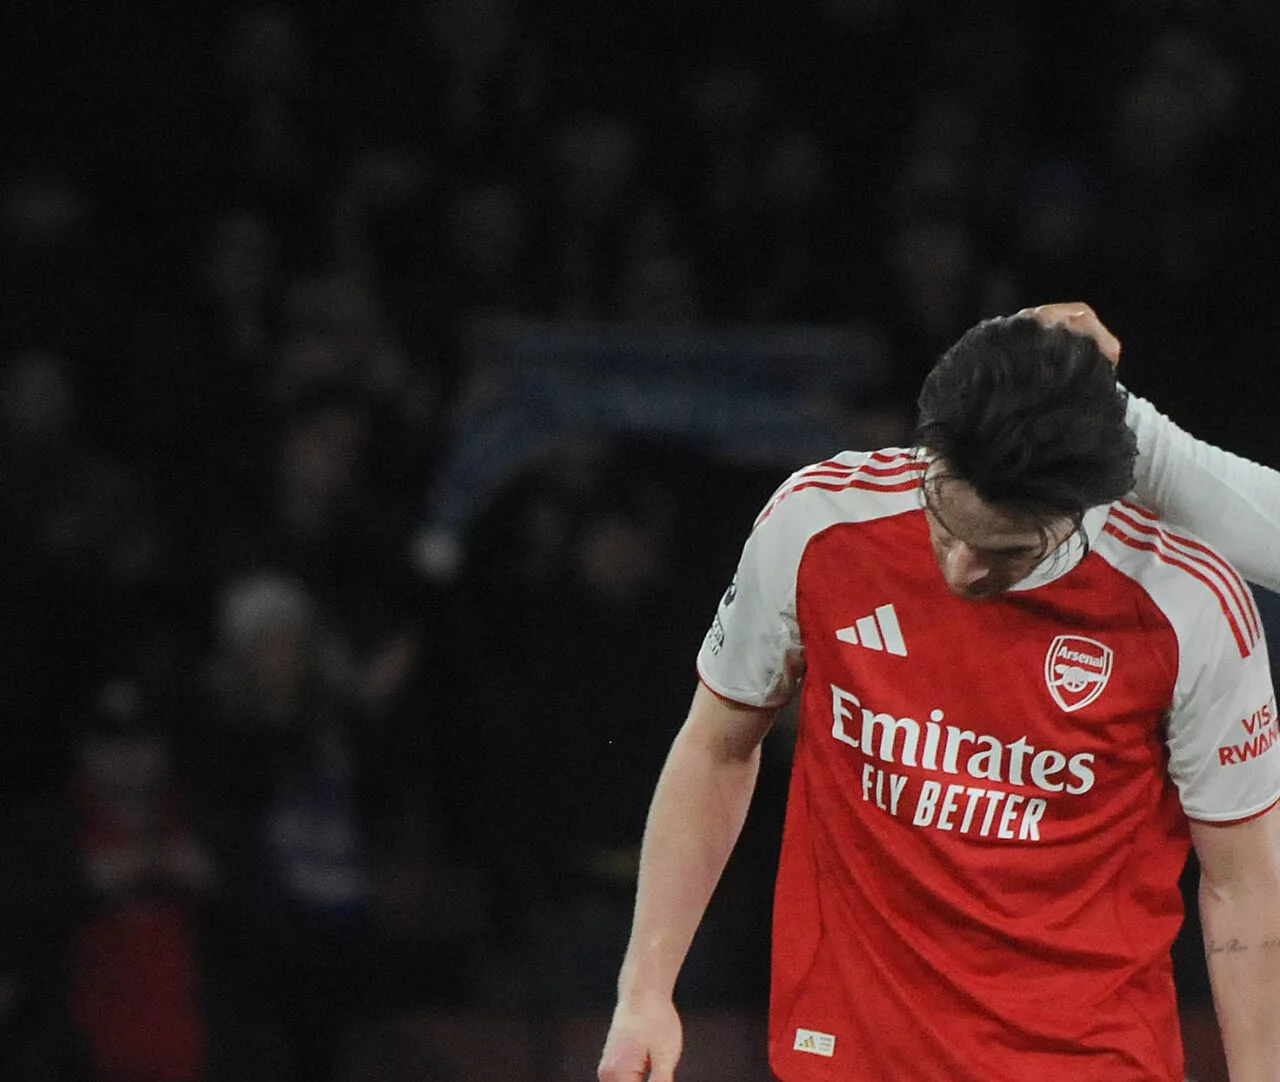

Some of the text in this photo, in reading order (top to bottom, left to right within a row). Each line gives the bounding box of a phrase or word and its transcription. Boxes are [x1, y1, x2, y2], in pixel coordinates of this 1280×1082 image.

[1057, 646, 1105, 668] Arsenal
[830, 683, 1096, 796] Emirates
[1241, 704, 1273, 735] VIS
[862, 763, 1048, 842] FLY BETTER
